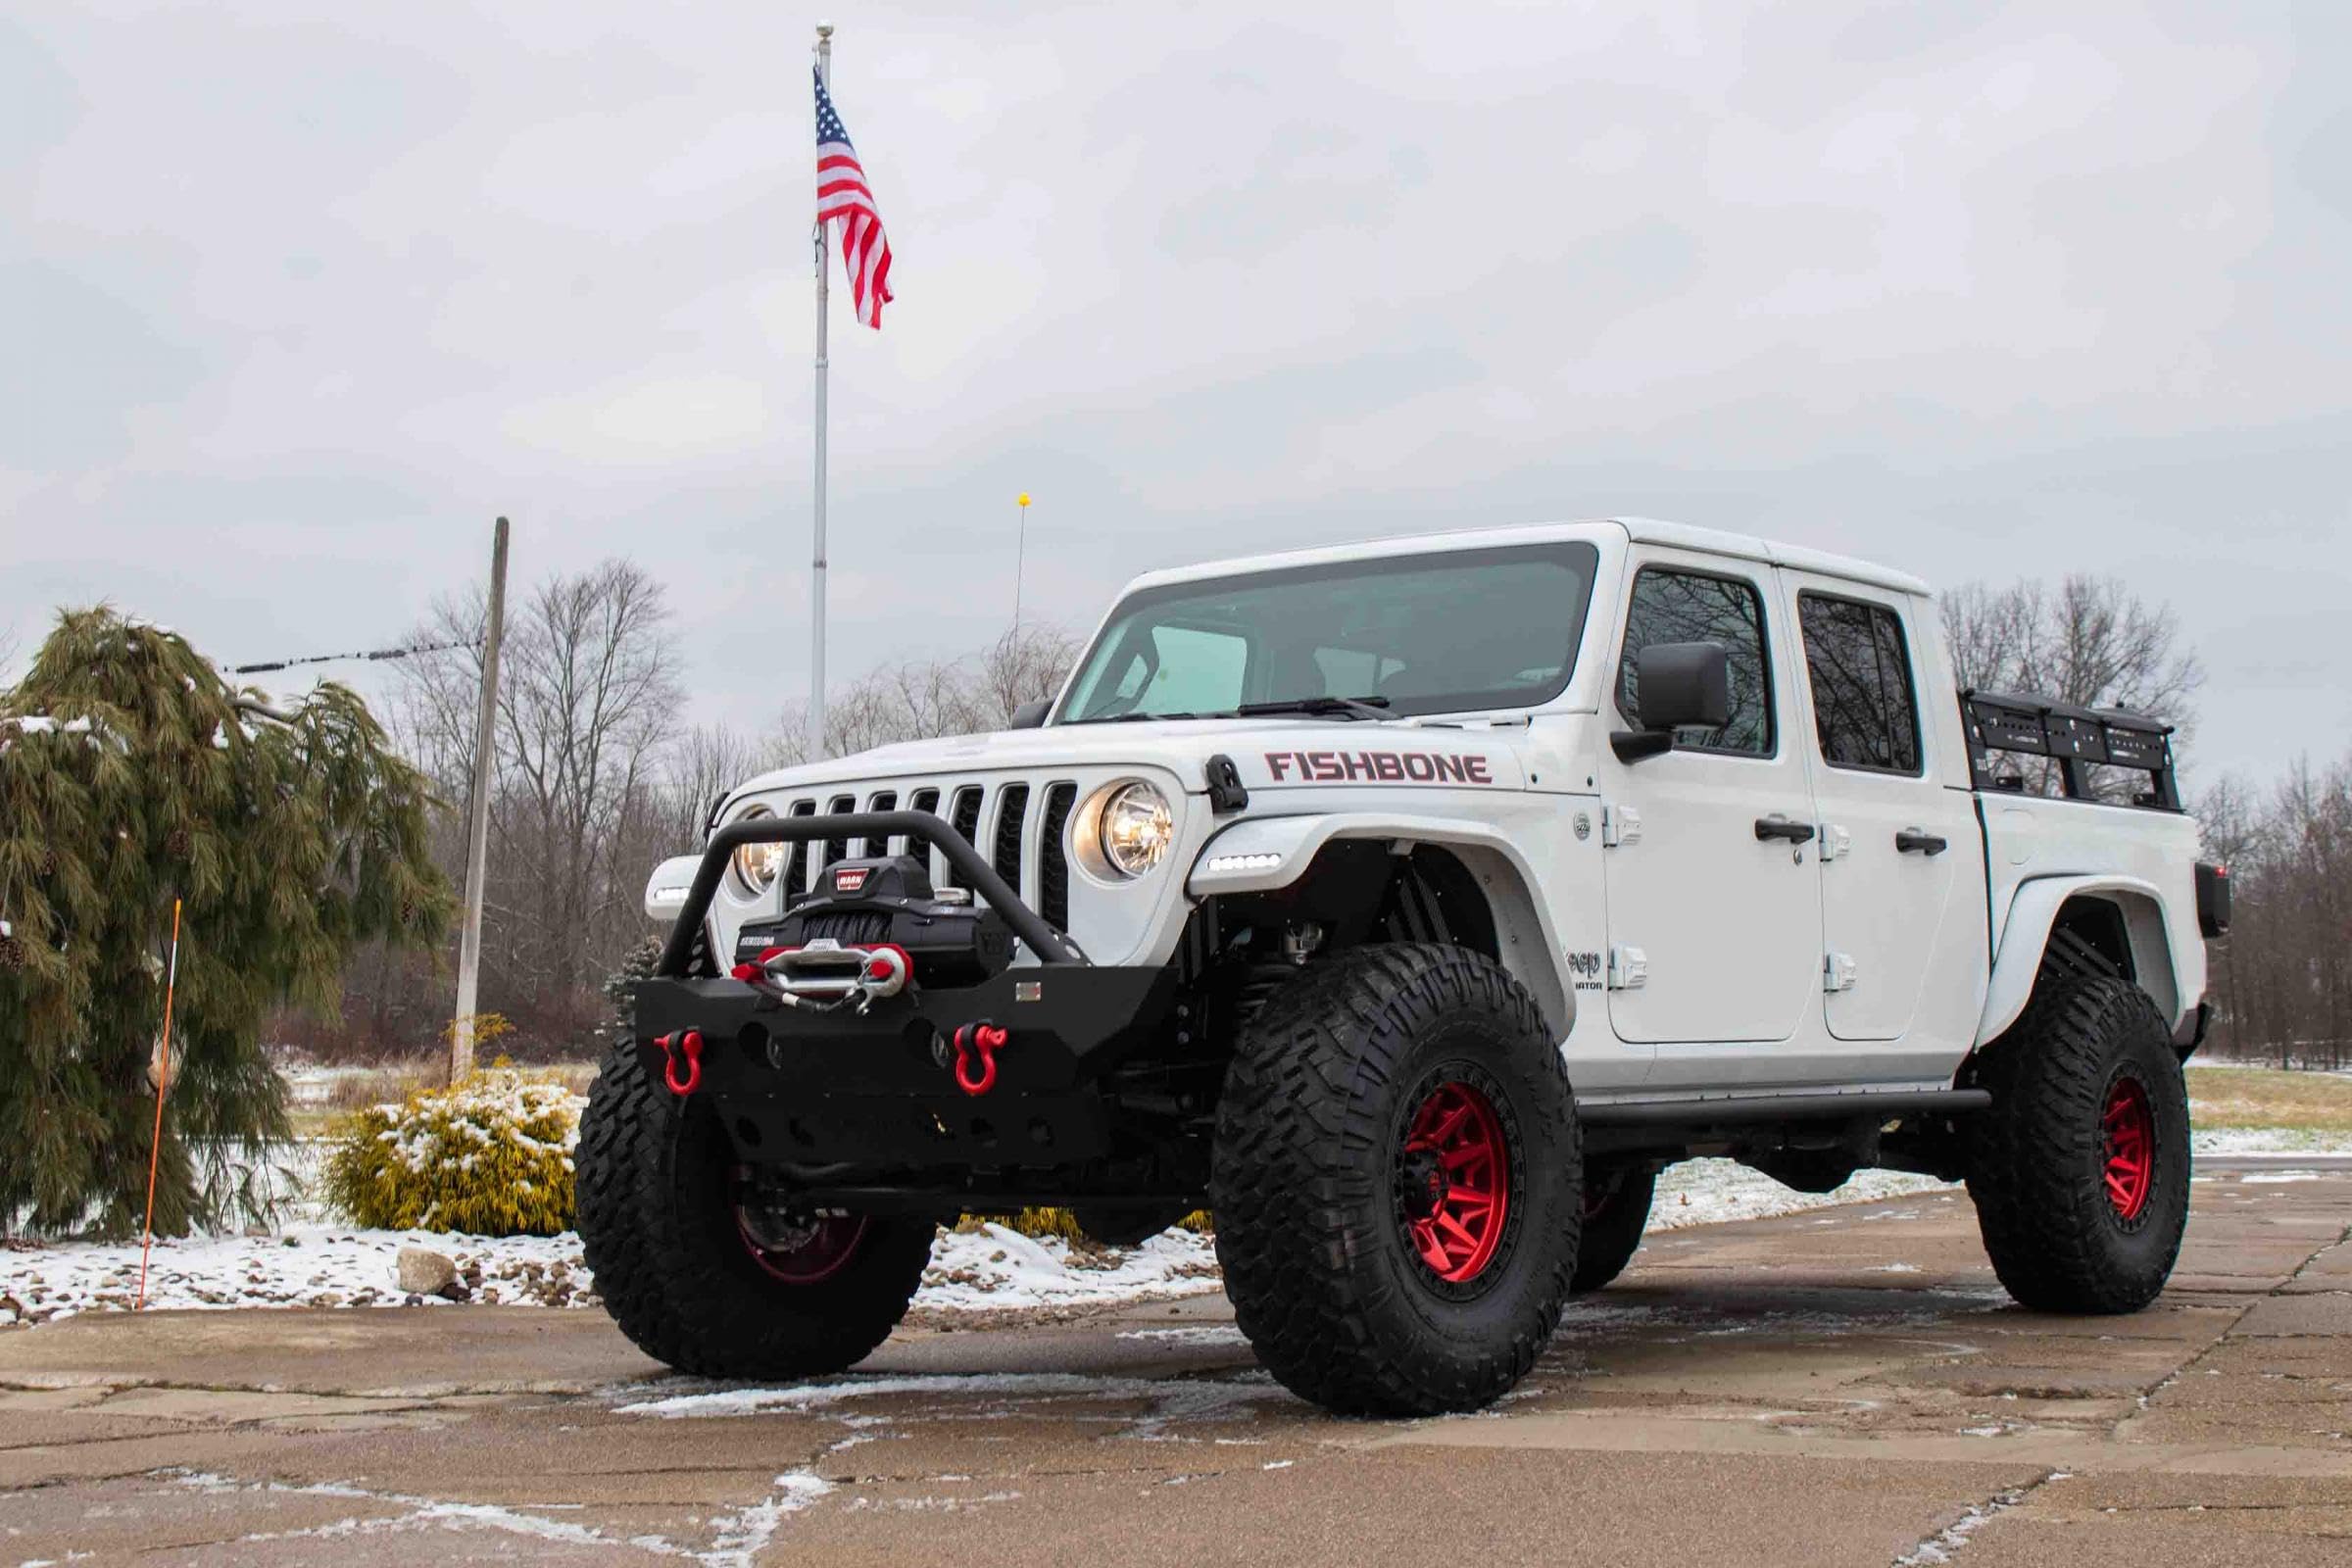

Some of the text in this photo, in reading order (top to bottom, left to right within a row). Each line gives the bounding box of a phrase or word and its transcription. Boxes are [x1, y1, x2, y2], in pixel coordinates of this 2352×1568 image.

[1264, 752, 1492, 783] FISHBONE
[840, 875, 862, 884] WARN
[1567, 952, 1600, 979] eep
